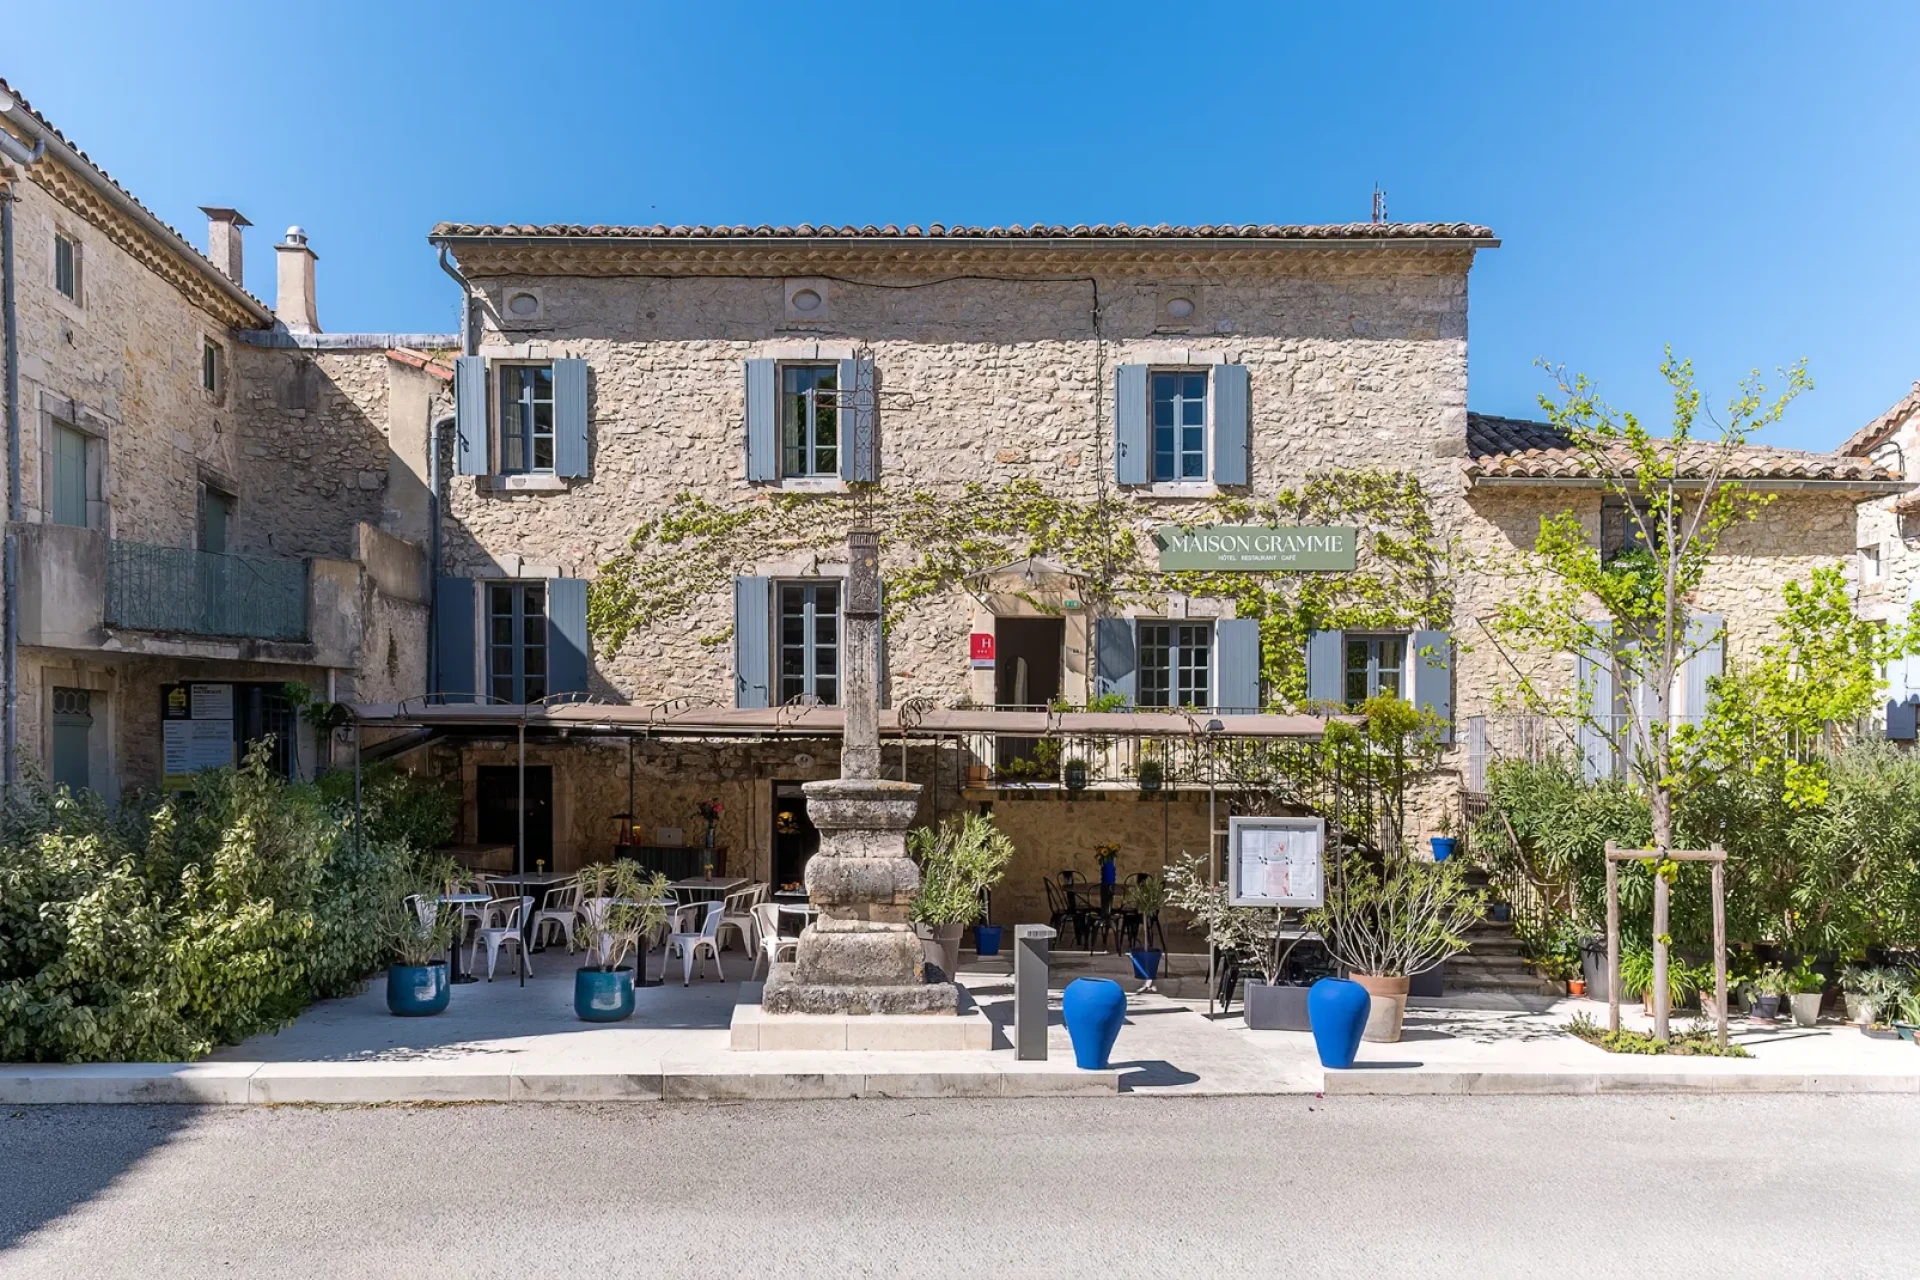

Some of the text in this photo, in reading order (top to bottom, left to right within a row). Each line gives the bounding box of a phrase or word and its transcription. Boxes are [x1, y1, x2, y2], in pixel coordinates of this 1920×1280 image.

[1172, 535, 1342, 553] MAISON GRAMME
[982, 638, 991, 648] H
